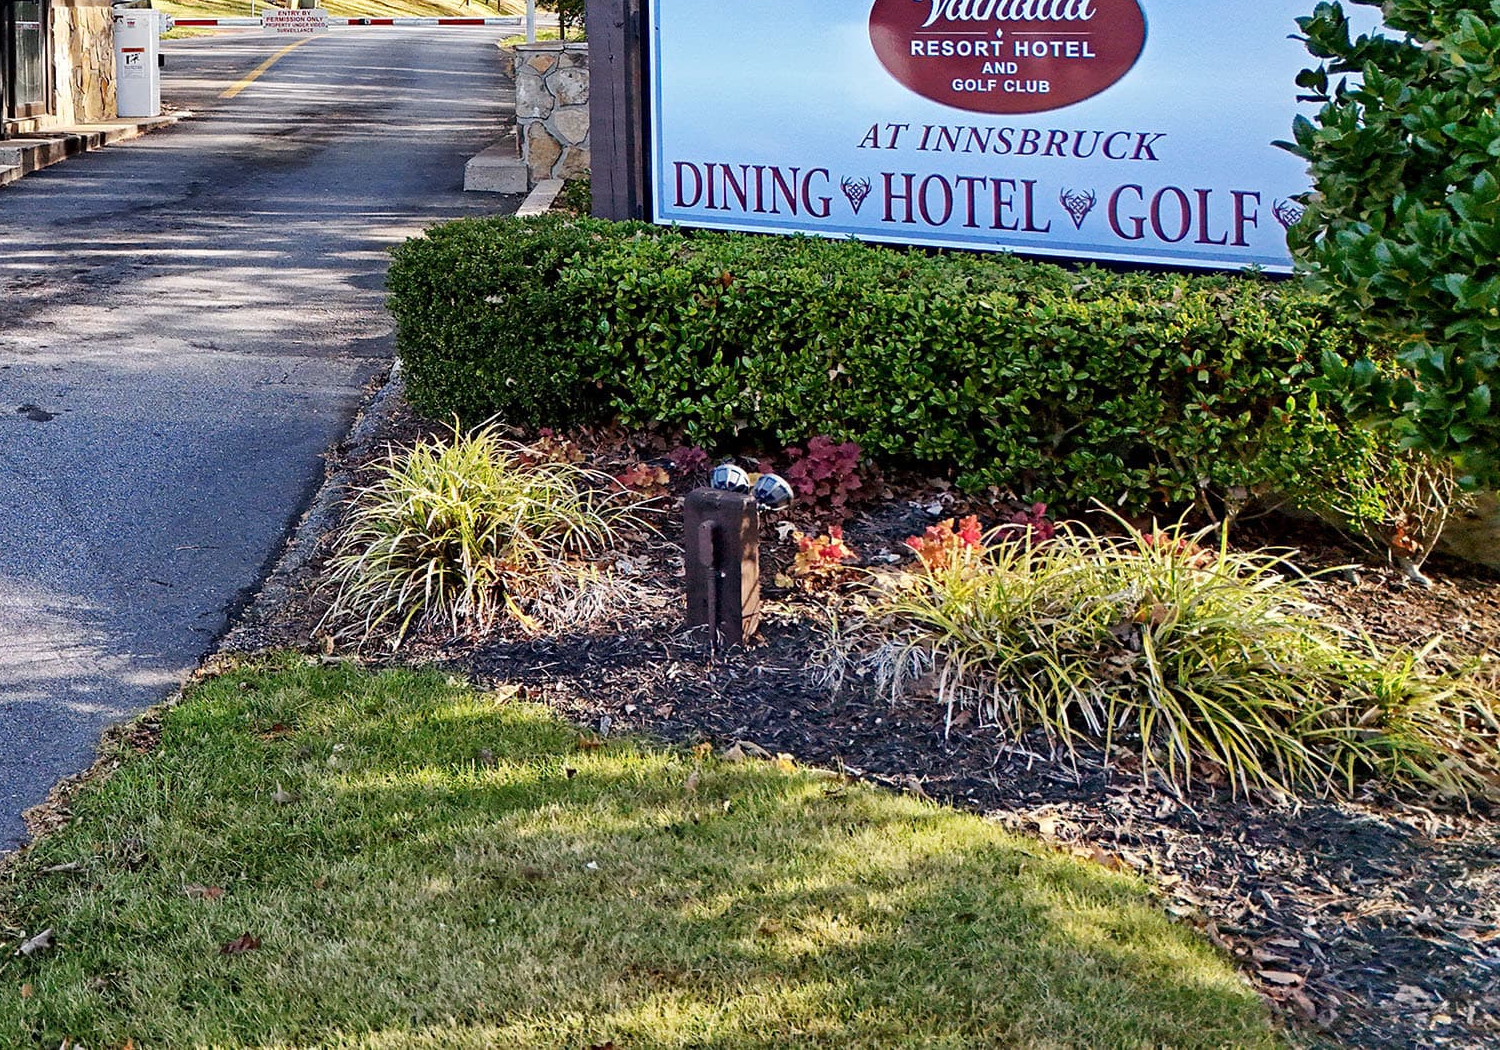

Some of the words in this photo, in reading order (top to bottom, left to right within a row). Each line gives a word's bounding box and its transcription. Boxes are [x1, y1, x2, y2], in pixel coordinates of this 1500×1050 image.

[910, 40, 1004, 57] RESORT
[1014, 40, 1096, 58] HOTEL
[981, 61, 1018, 75] AND
[952, 79, 997, 92] GOLF
[1003, 79, 1050, 93] CLUB
[856, 122, 910, 150] AT
[915, 124, 1167, 162] INNSBRUCK
[672, 160, 832, 219] DINING
[880, 171, 1051, 233] HOTEL
[1107, 182, 1261, 247] GOLF
